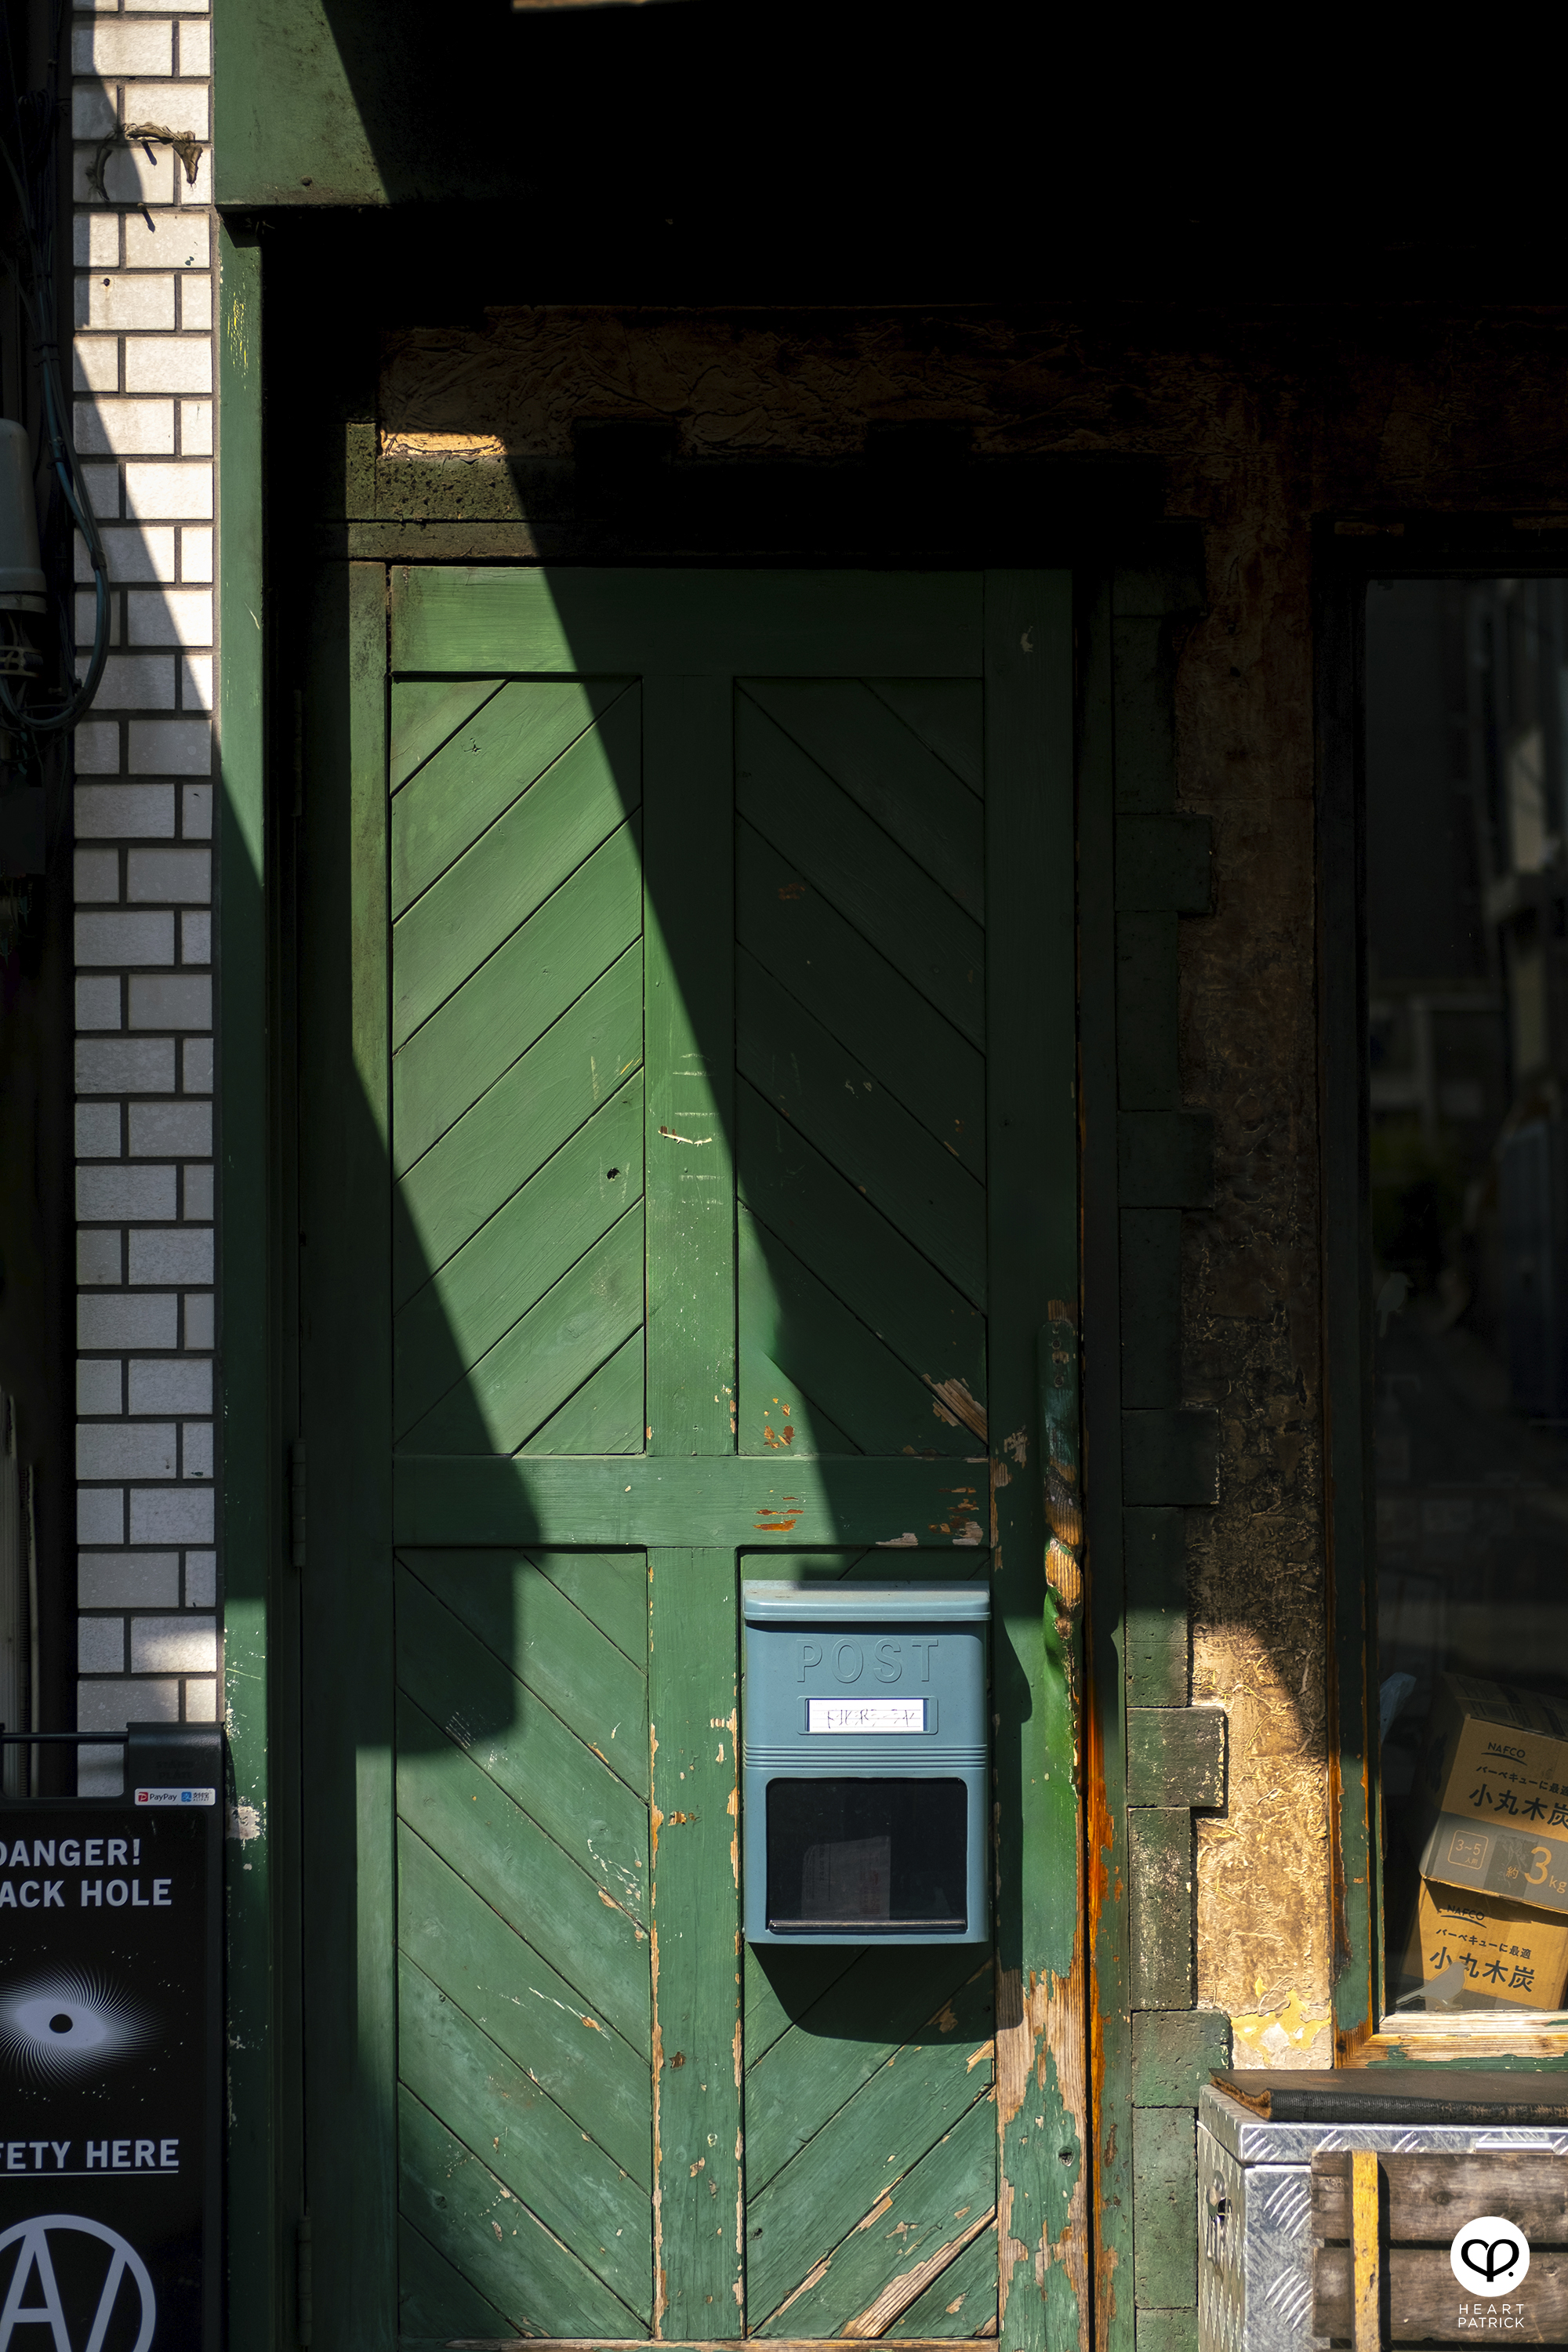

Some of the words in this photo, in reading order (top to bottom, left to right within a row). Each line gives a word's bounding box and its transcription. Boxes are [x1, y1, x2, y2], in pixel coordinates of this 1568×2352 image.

[797, 1638, 939, 1683] POST
[1487, 1741, 1526, 1759] NAFCO
[149, 1793, 177, 1802] PayPay
[1468, 1783, 1568, 1830] 小丸木炭
[81, 1878, 172, 1907] HOLE
[1447, 1904, 1485, 1921] NAFCO
[1436, 1929, 1532, 1960] バーベキューに最適
[1429, 1946, 1535, 1993] 小丸木炭
[0, 2141, 71, 2170] ETY
[86, 2139, 180, 2169] HERE
